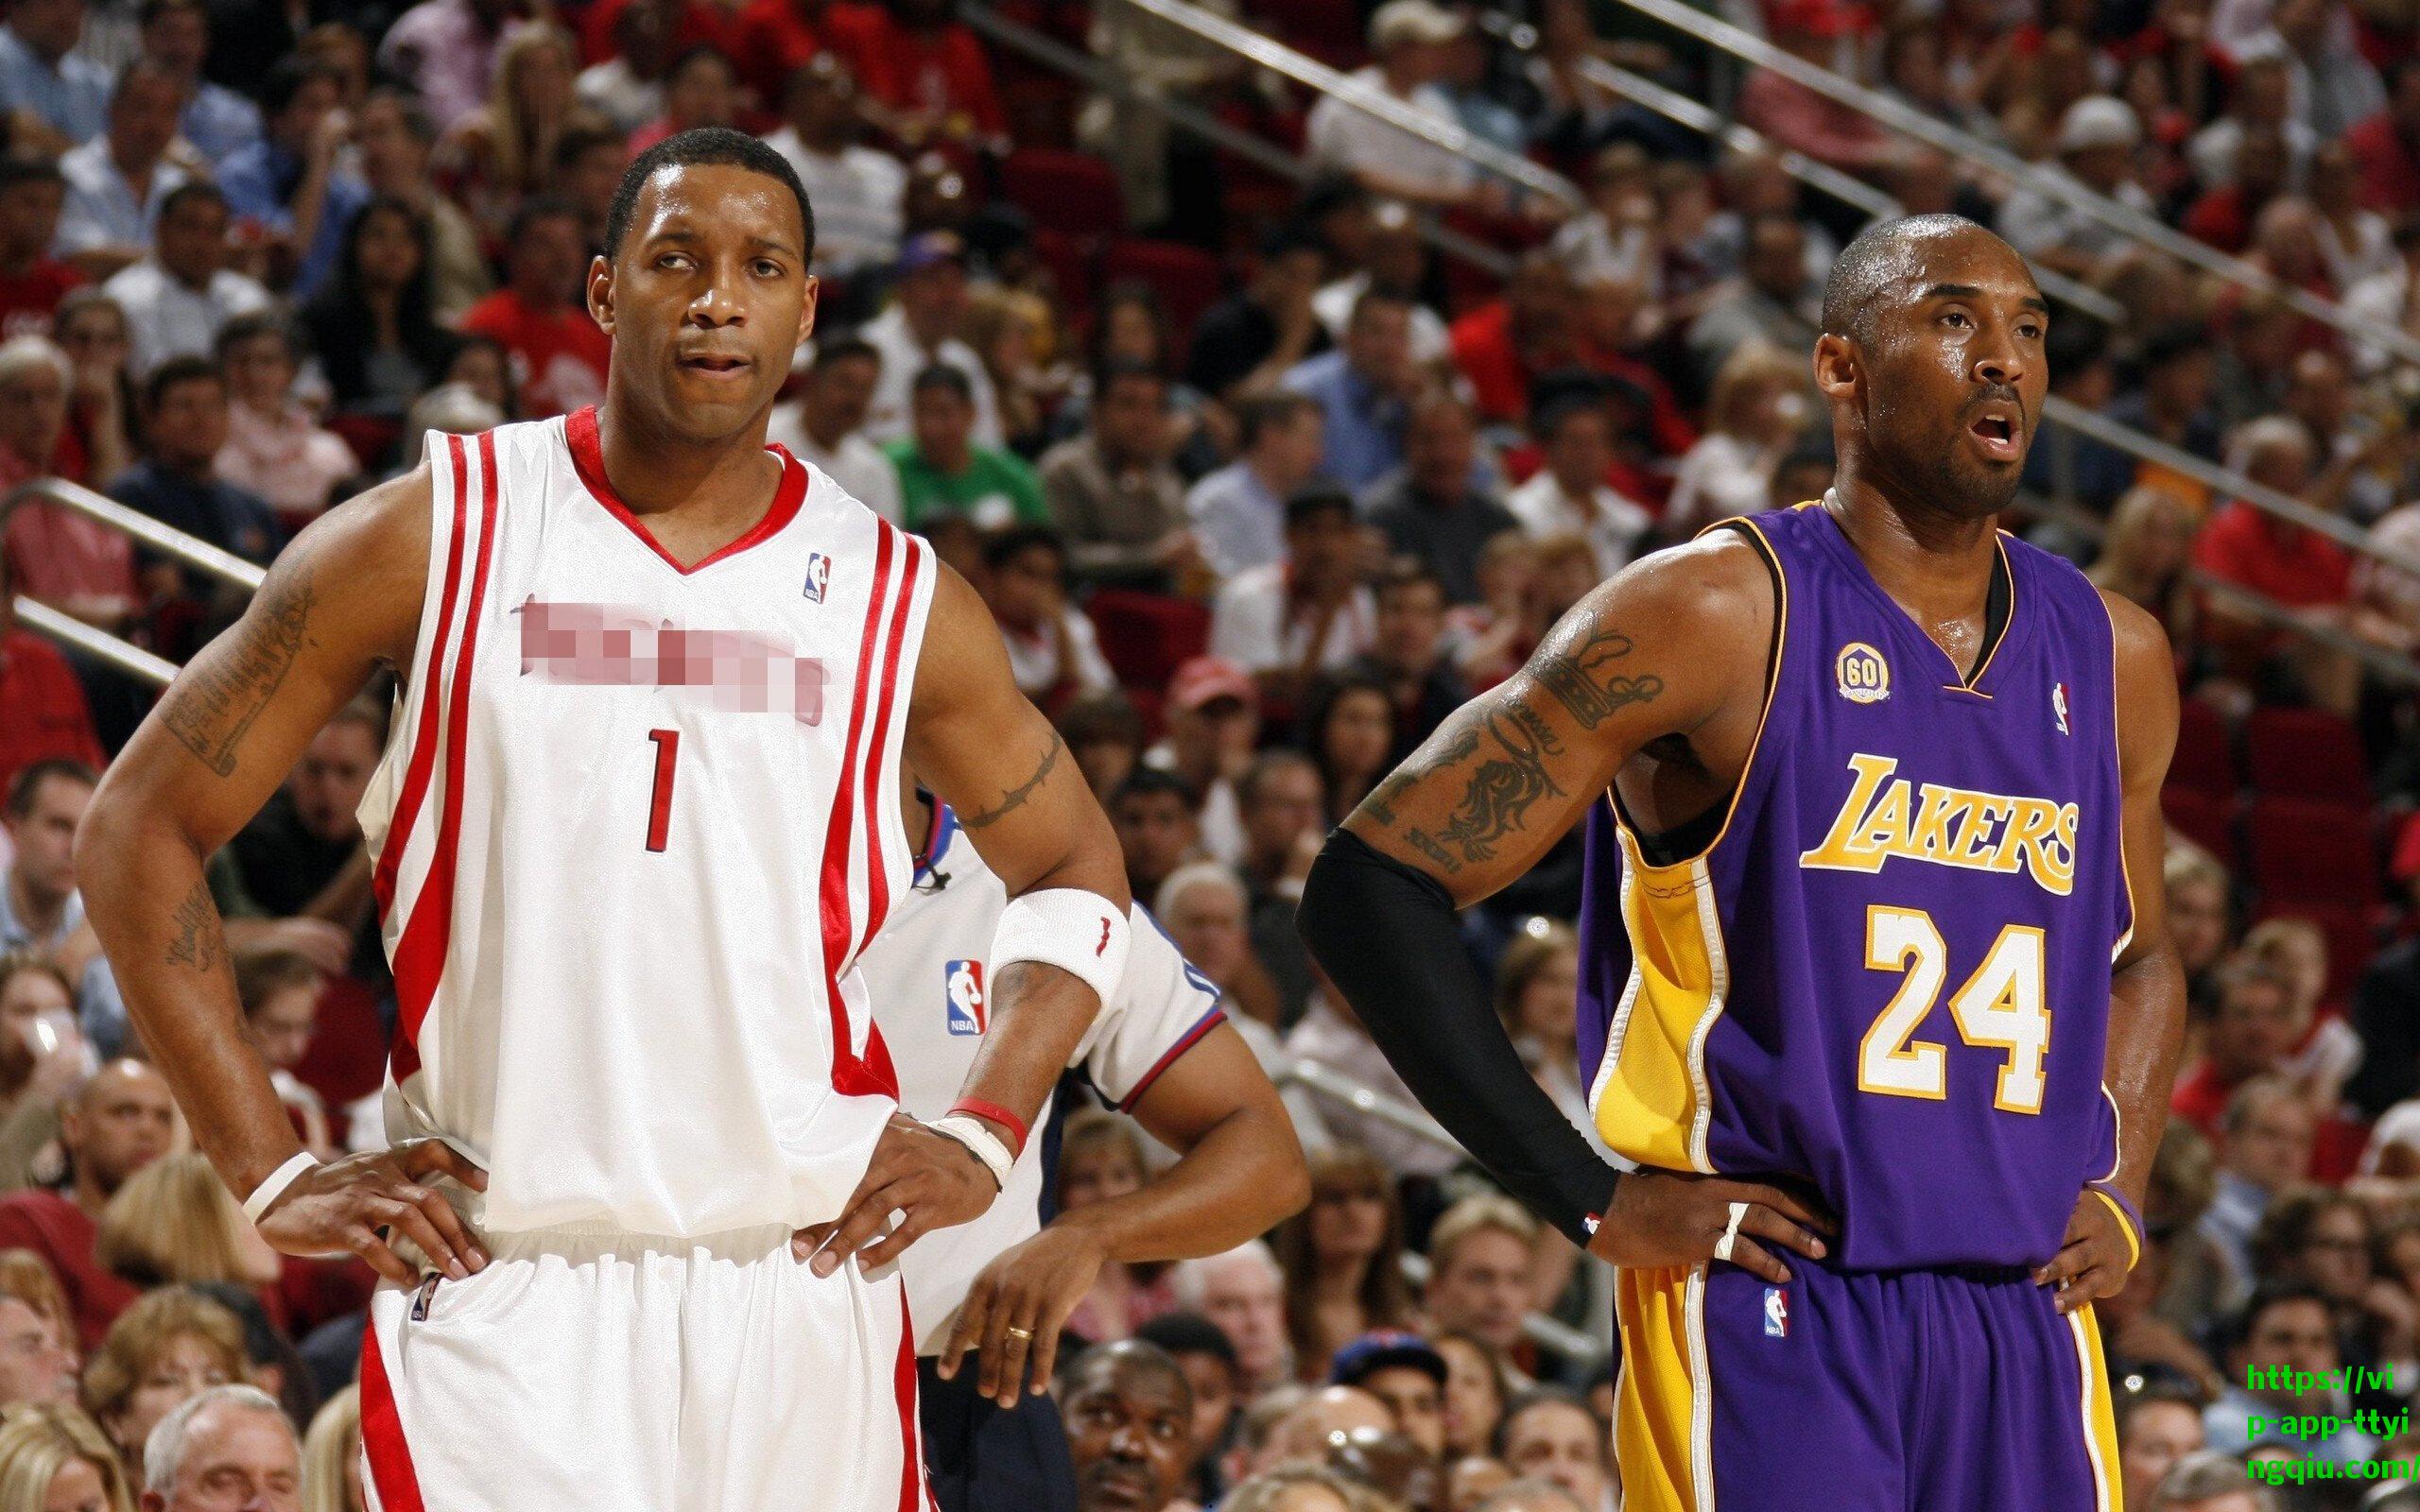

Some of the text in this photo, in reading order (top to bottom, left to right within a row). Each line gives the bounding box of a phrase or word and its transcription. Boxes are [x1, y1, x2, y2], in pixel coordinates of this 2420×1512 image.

[1846, 657, 1877, 687] 60
[646, 729, 680, 852] 1
[1799, 752, 2080, 896] LAKERS
[950, 1020, 974, 1031] NBA
[1858, 904, 2051, 1115] 24
